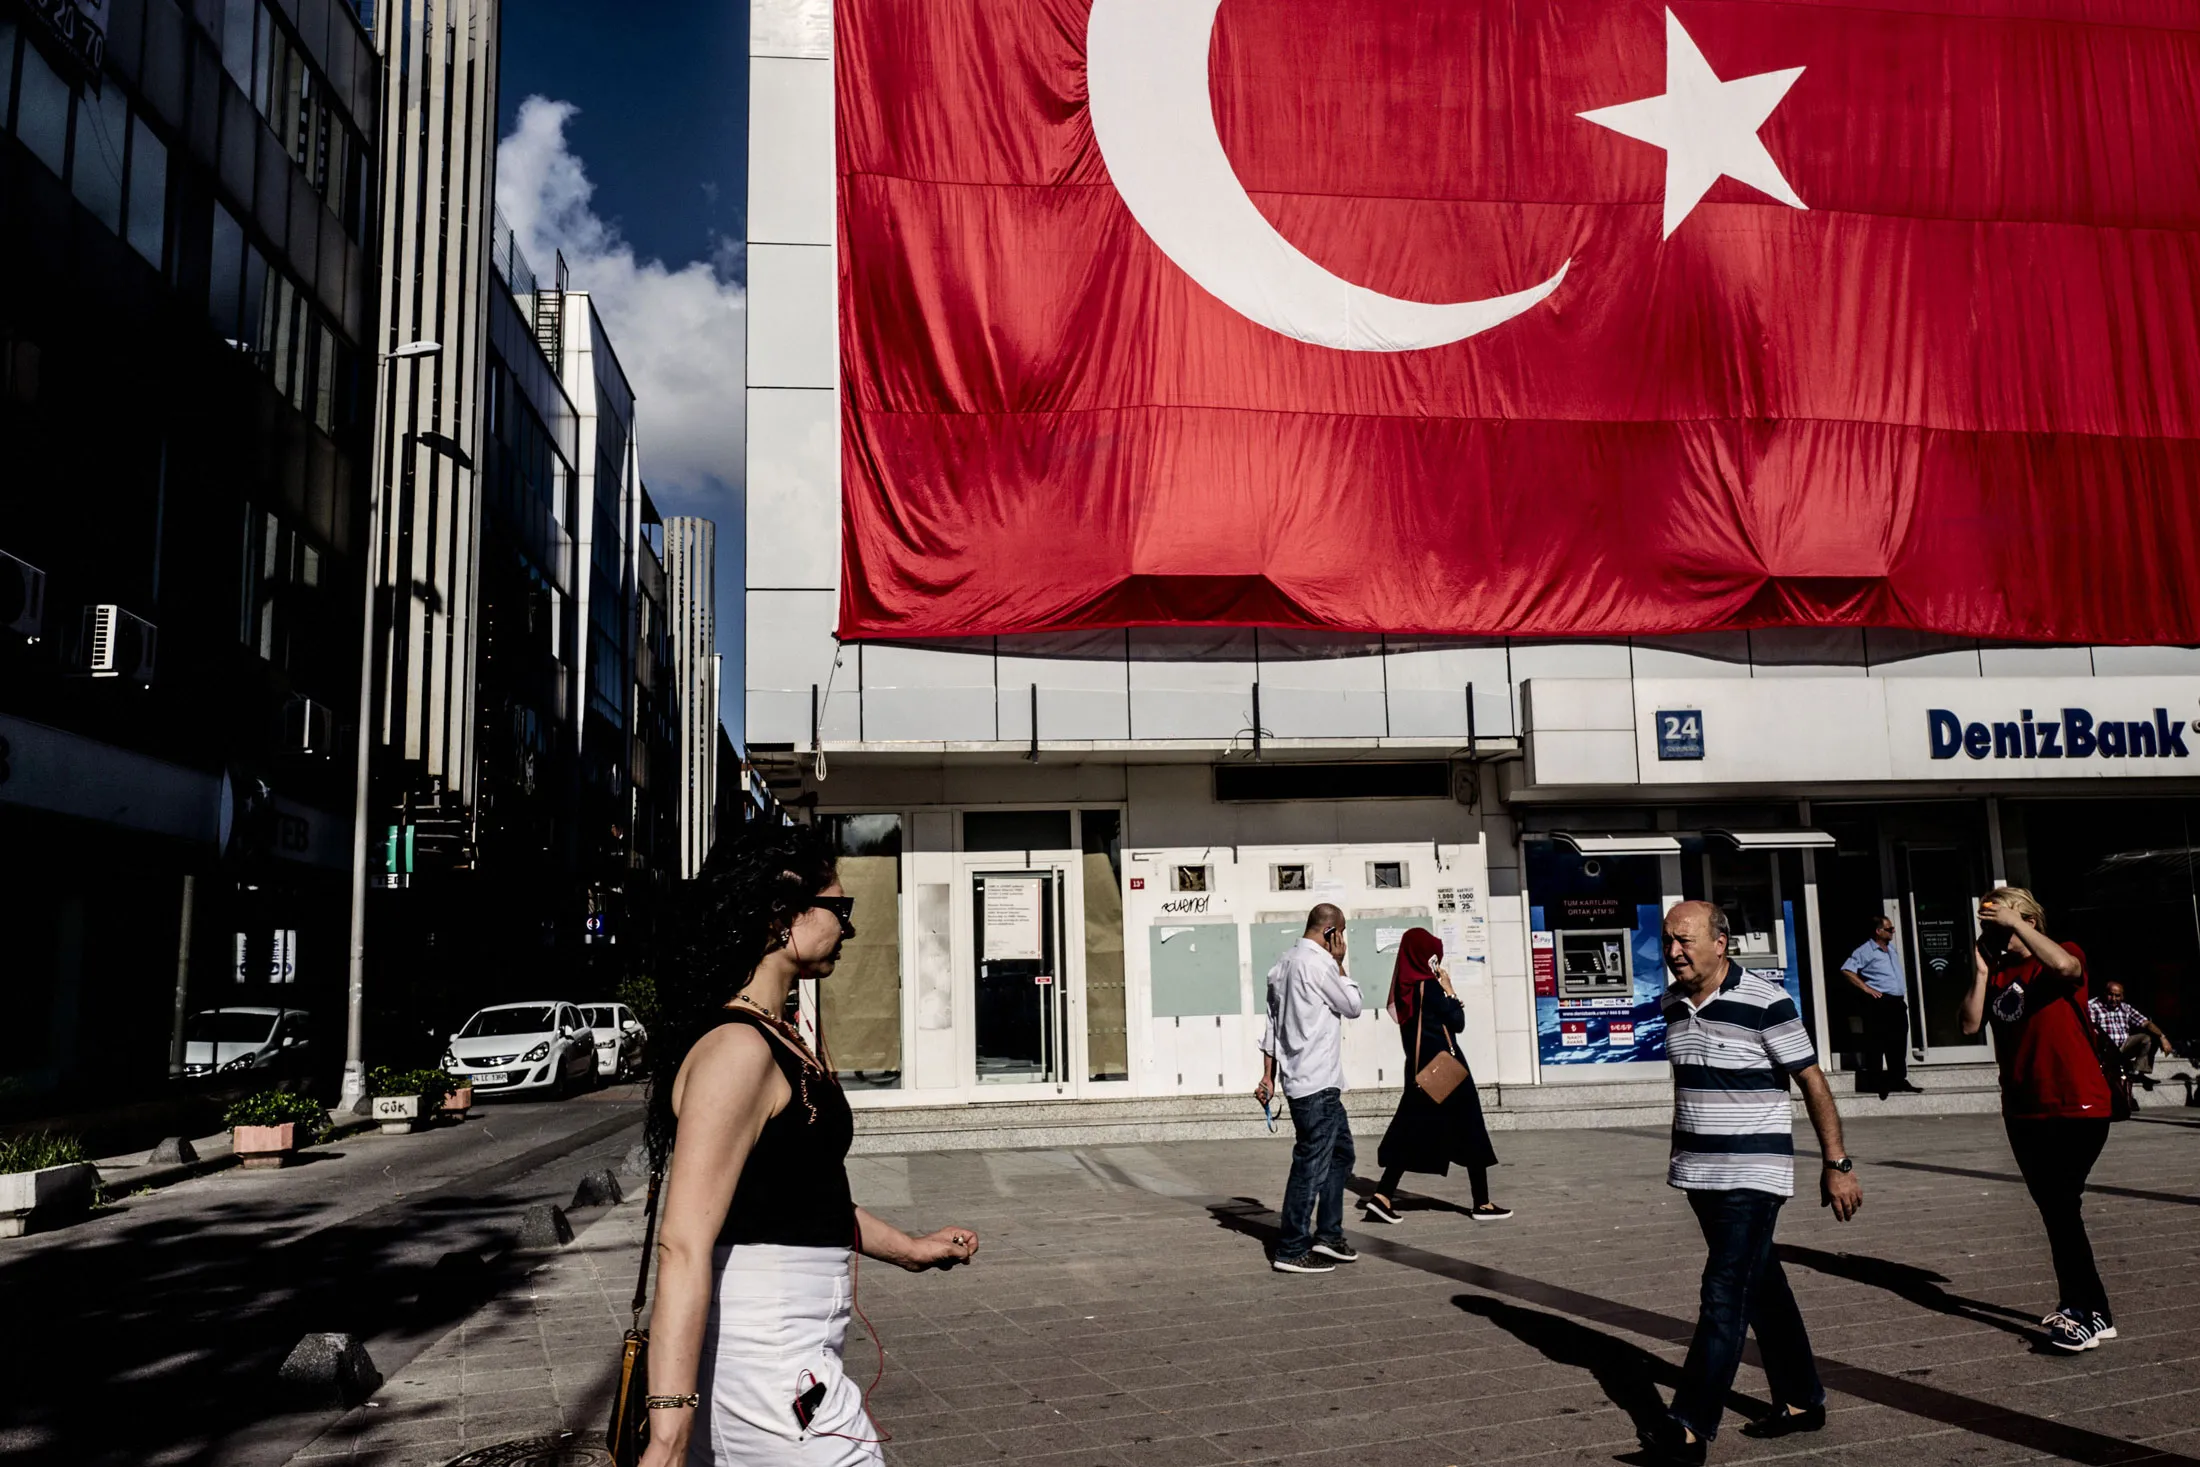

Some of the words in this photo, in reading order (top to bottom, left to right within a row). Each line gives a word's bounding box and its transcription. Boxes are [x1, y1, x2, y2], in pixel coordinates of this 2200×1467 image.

[82, 21, 103, 68] 70
[1664, 716, 1699, 740] 24
[1926, 707, 2190, 760] DenizBank
[1567, 908, 1591, 916] ORTAK
